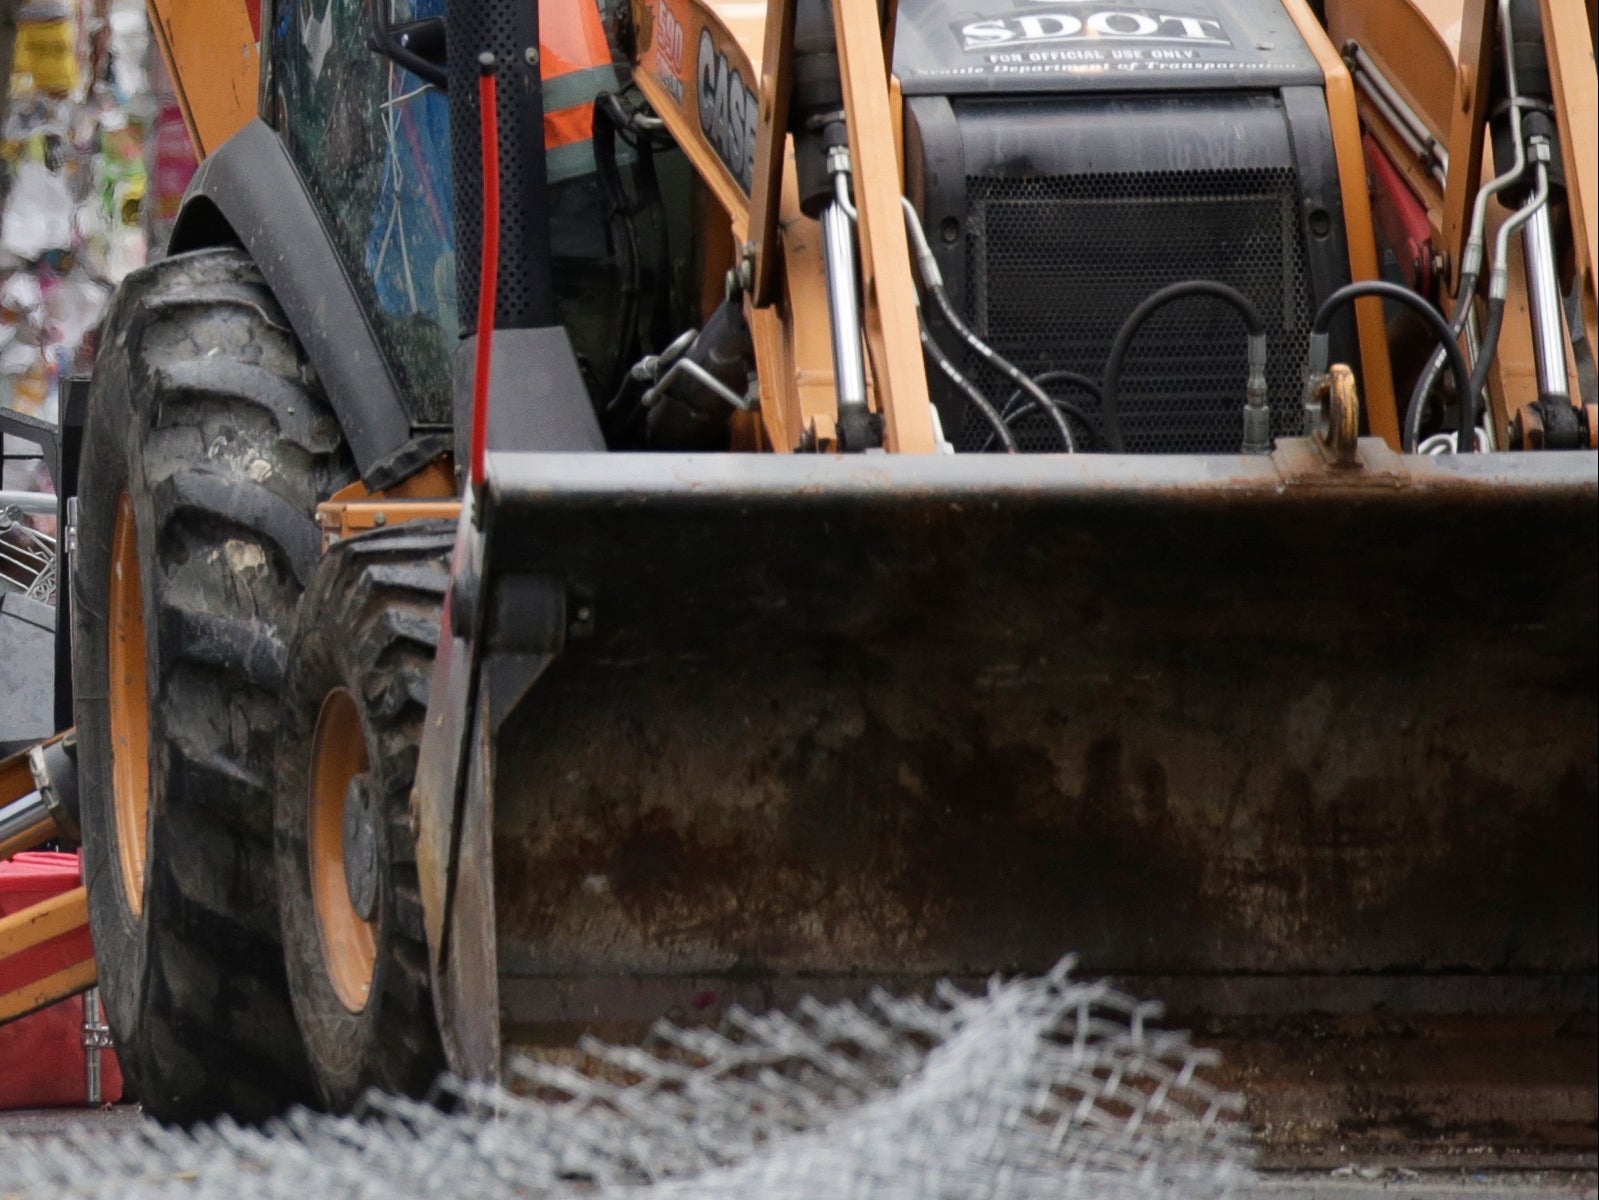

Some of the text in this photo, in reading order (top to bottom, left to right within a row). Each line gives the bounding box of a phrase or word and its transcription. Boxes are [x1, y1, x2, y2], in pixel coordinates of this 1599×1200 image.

[961, 11, 1223, 48] SDOT
[990, 49, 1195, 64] FOR OFFICIAL USE ONLY
[993, 63, 1110, 75] Department
[1118, 61, 1140, 72] of
